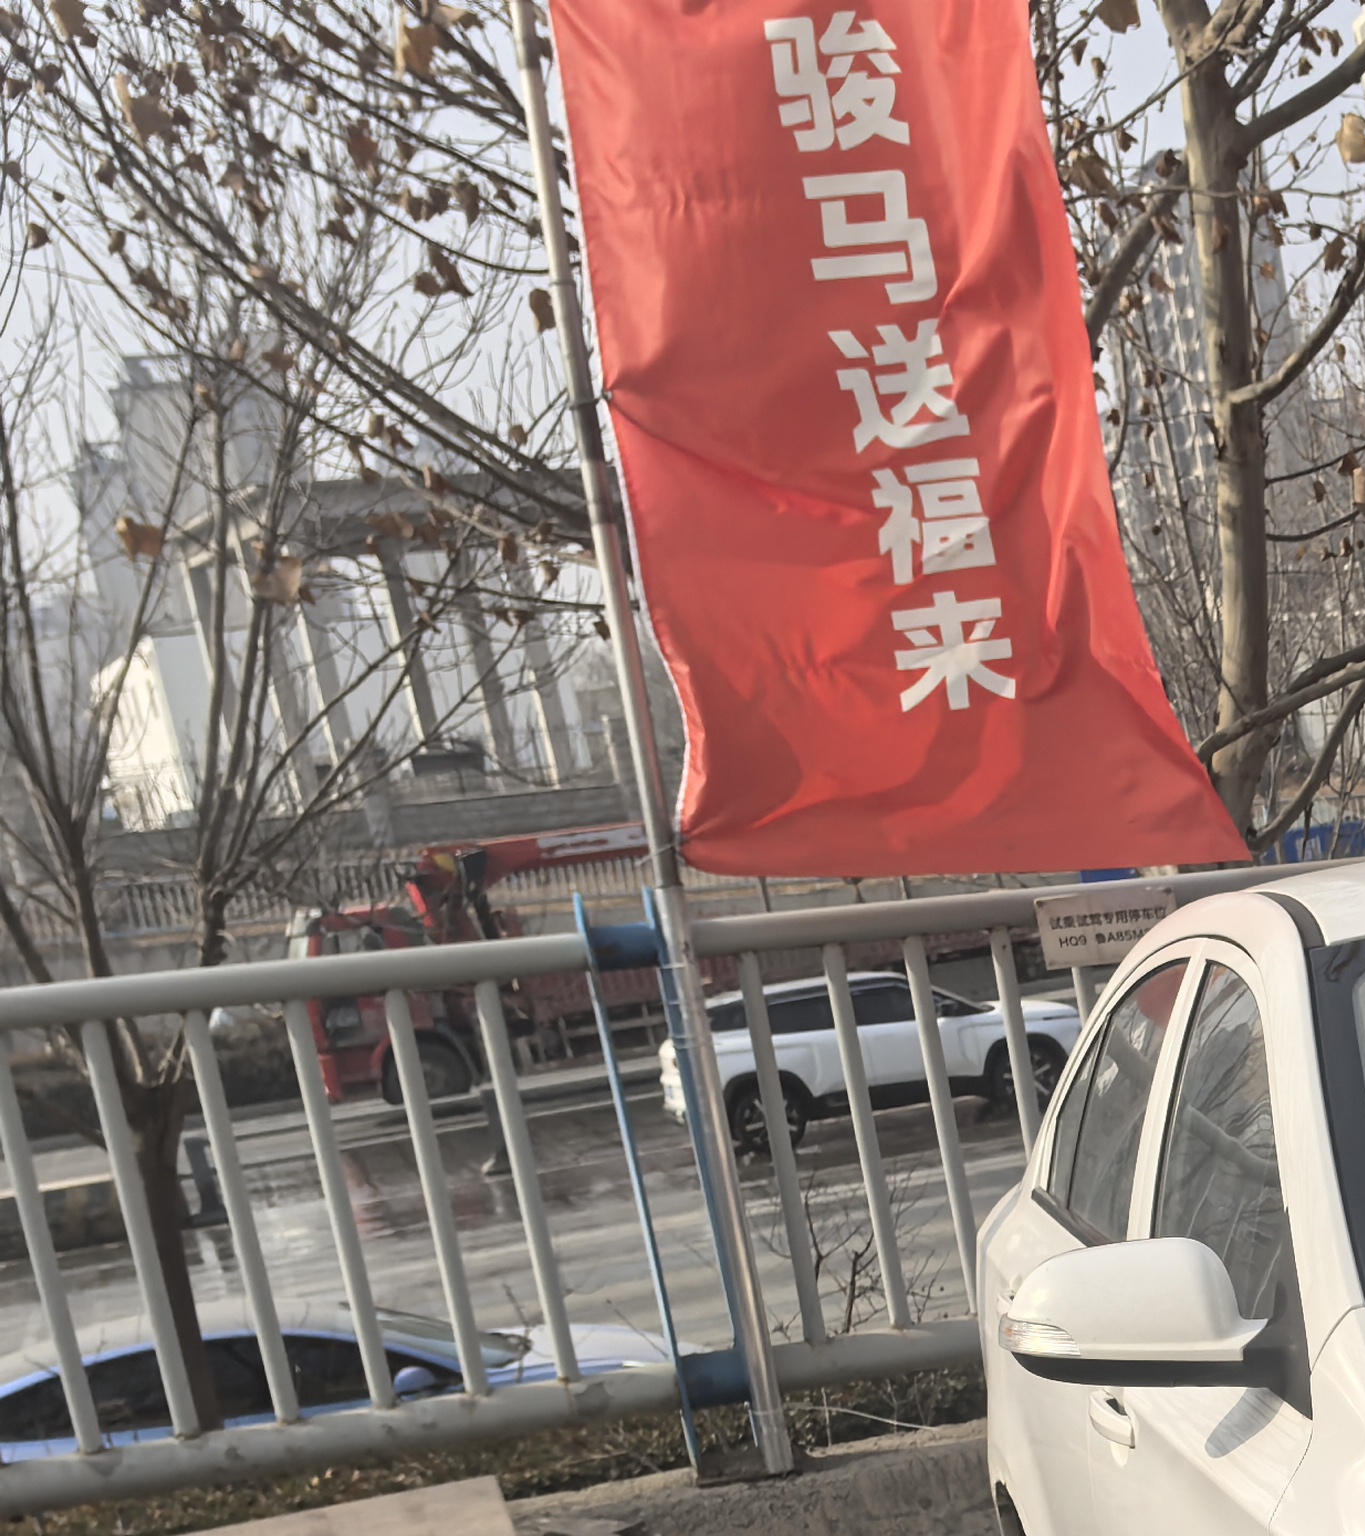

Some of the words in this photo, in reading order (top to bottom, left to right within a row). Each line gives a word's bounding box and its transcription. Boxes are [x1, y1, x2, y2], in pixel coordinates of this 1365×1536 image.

[764, 10, 1016, 712] 骏马送福来
